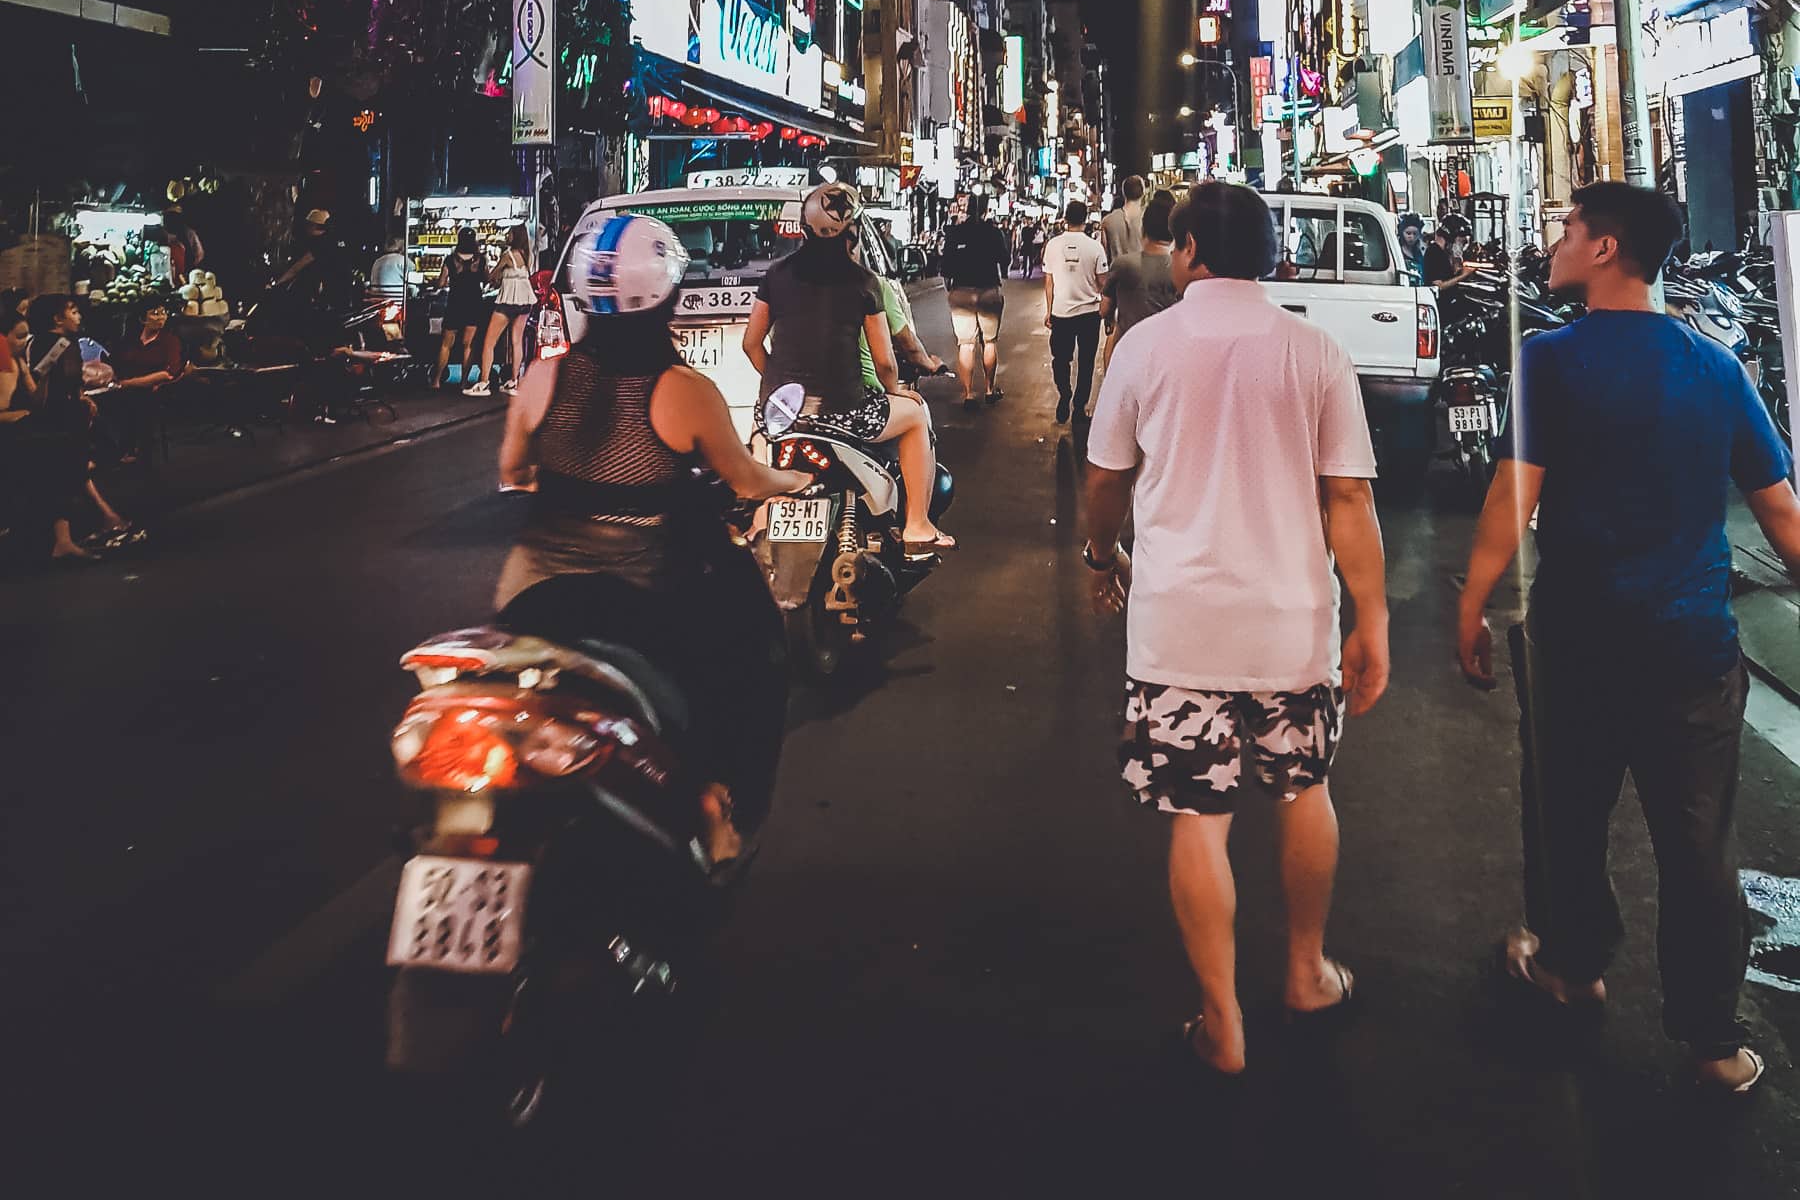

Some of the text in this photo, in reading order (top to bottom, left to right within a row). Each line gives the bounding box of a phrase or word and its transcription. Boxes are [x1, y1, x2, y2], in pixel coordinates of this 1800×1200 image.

[708, 291, 757, 307] 38.2
[680, 330, 710, 347] 51F
[1455, 419, 1482, 430] 9819
